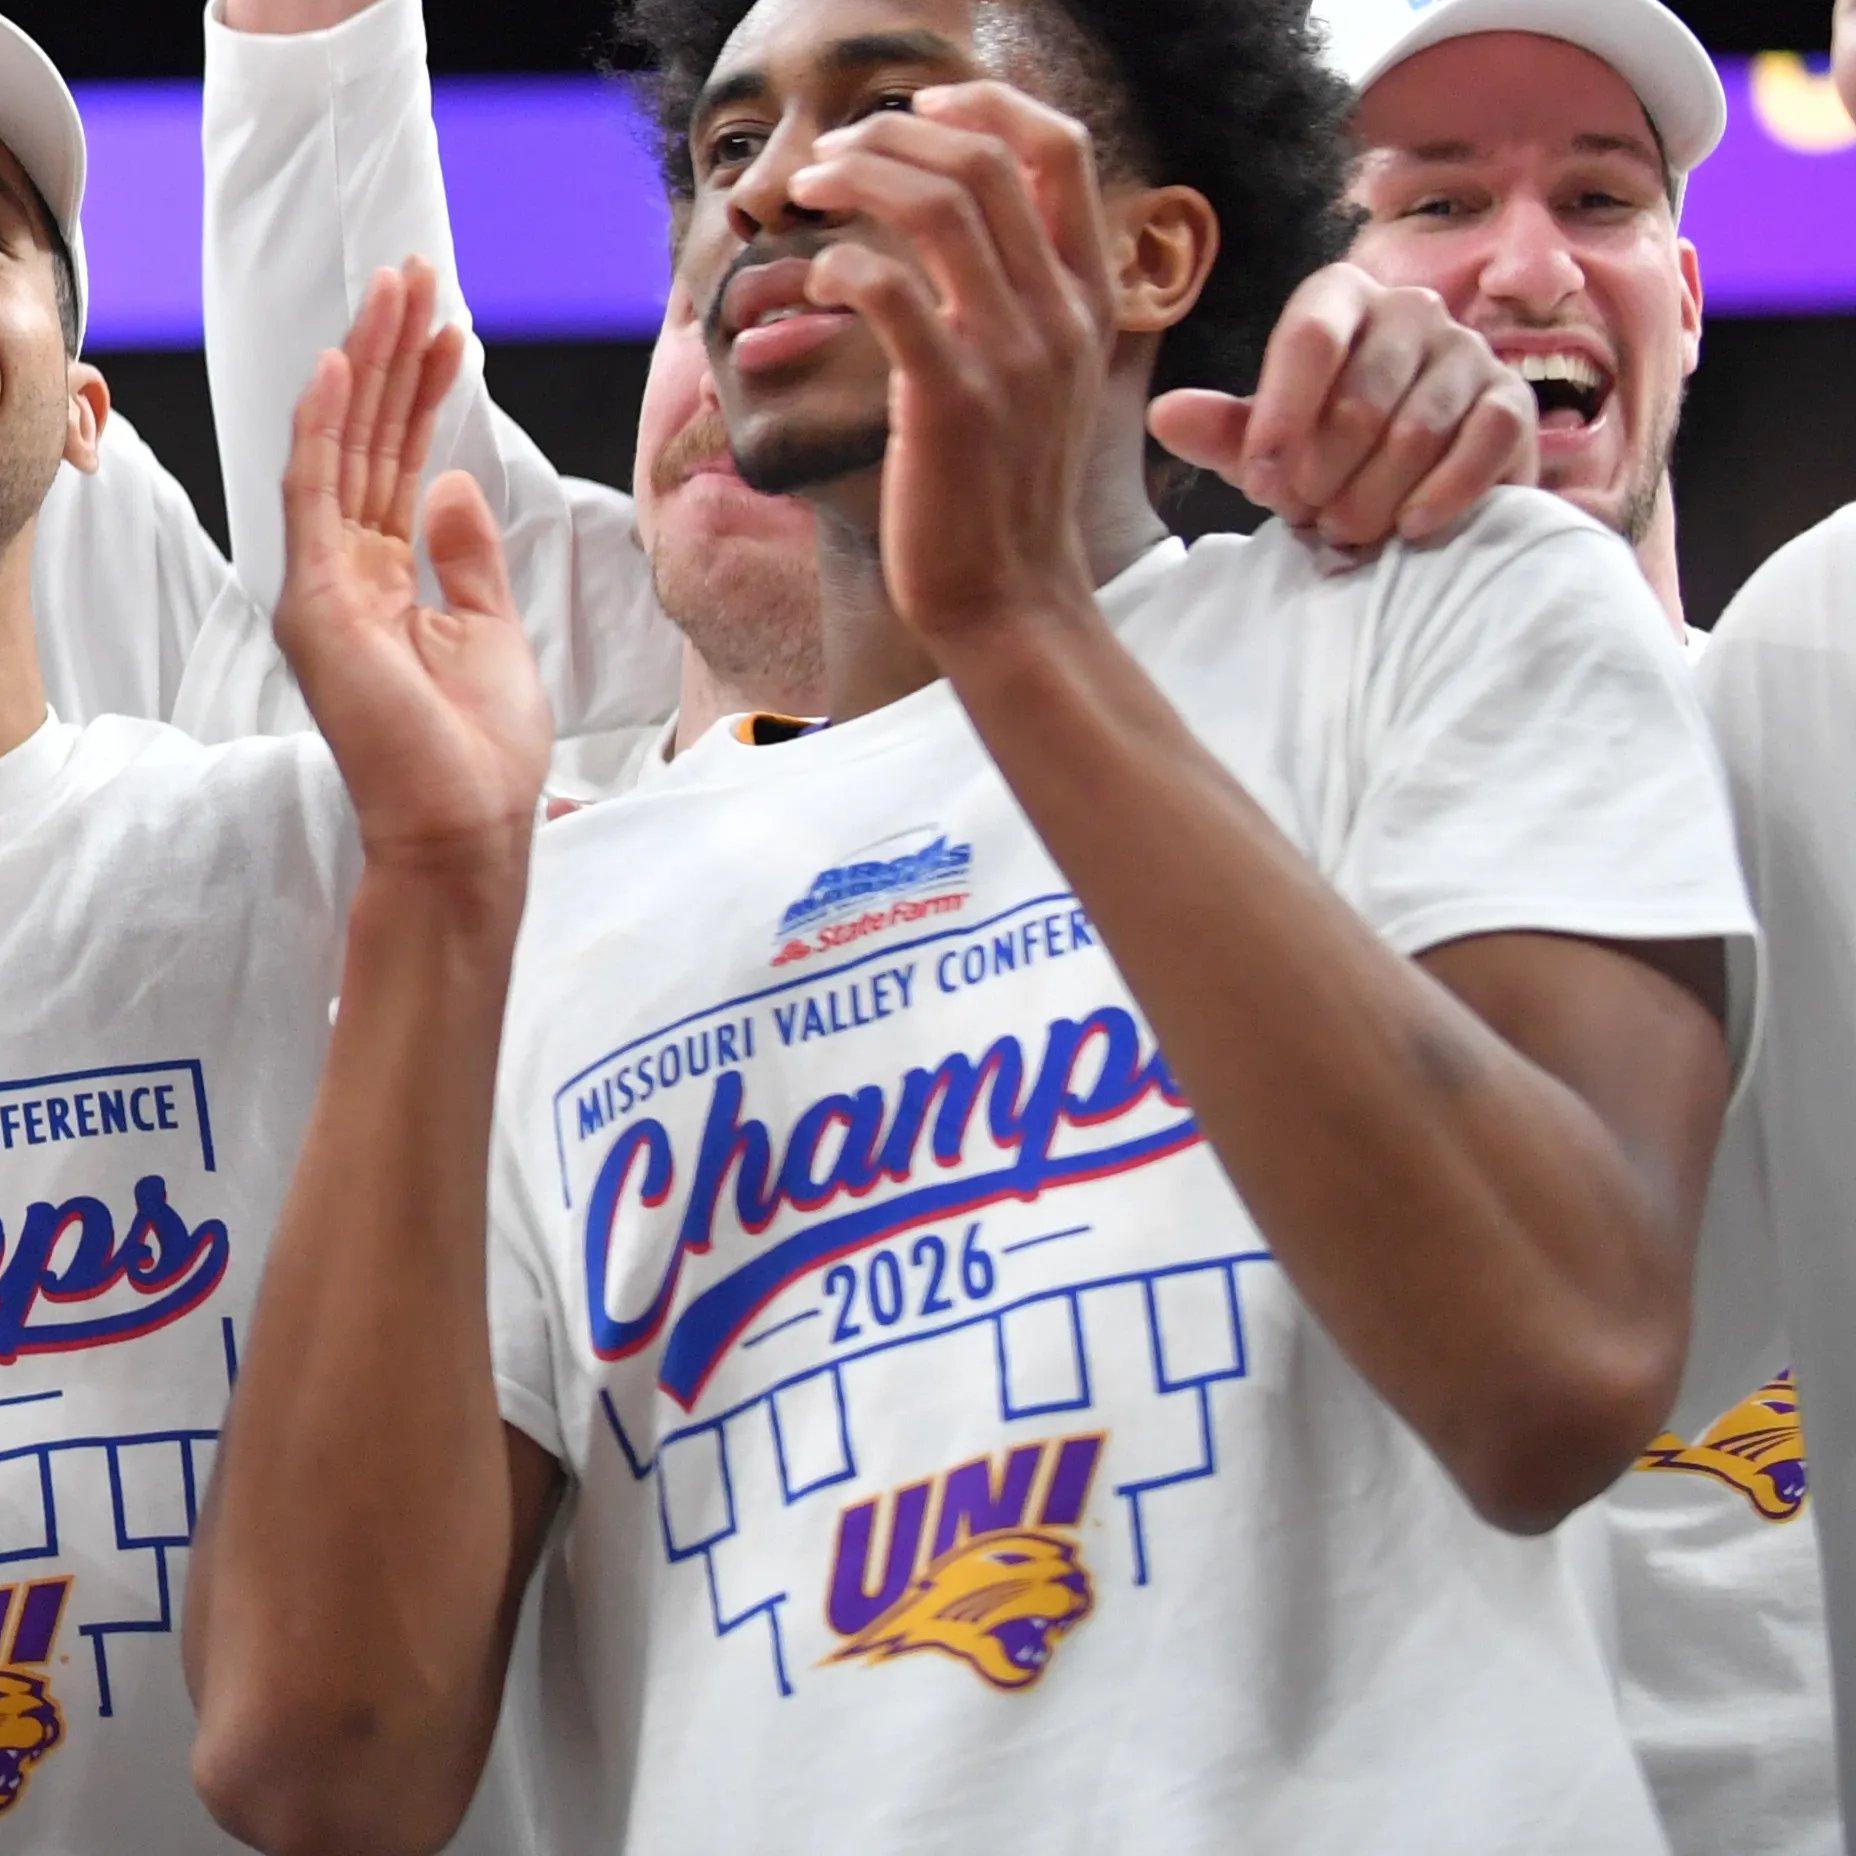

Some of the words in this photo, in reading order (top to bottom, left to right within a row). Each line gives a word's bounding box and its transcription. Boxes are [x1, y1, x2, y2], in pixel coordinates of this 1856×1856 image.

[577, 1017, 755, 1142] MISSOURI
[772, 963, 915, 1047] VALLEY
[937, 907, 1095, 994] CONFER
[823, 1222, 996, 1344] 2026
[826, 1430, 1110, 1635] UNI
